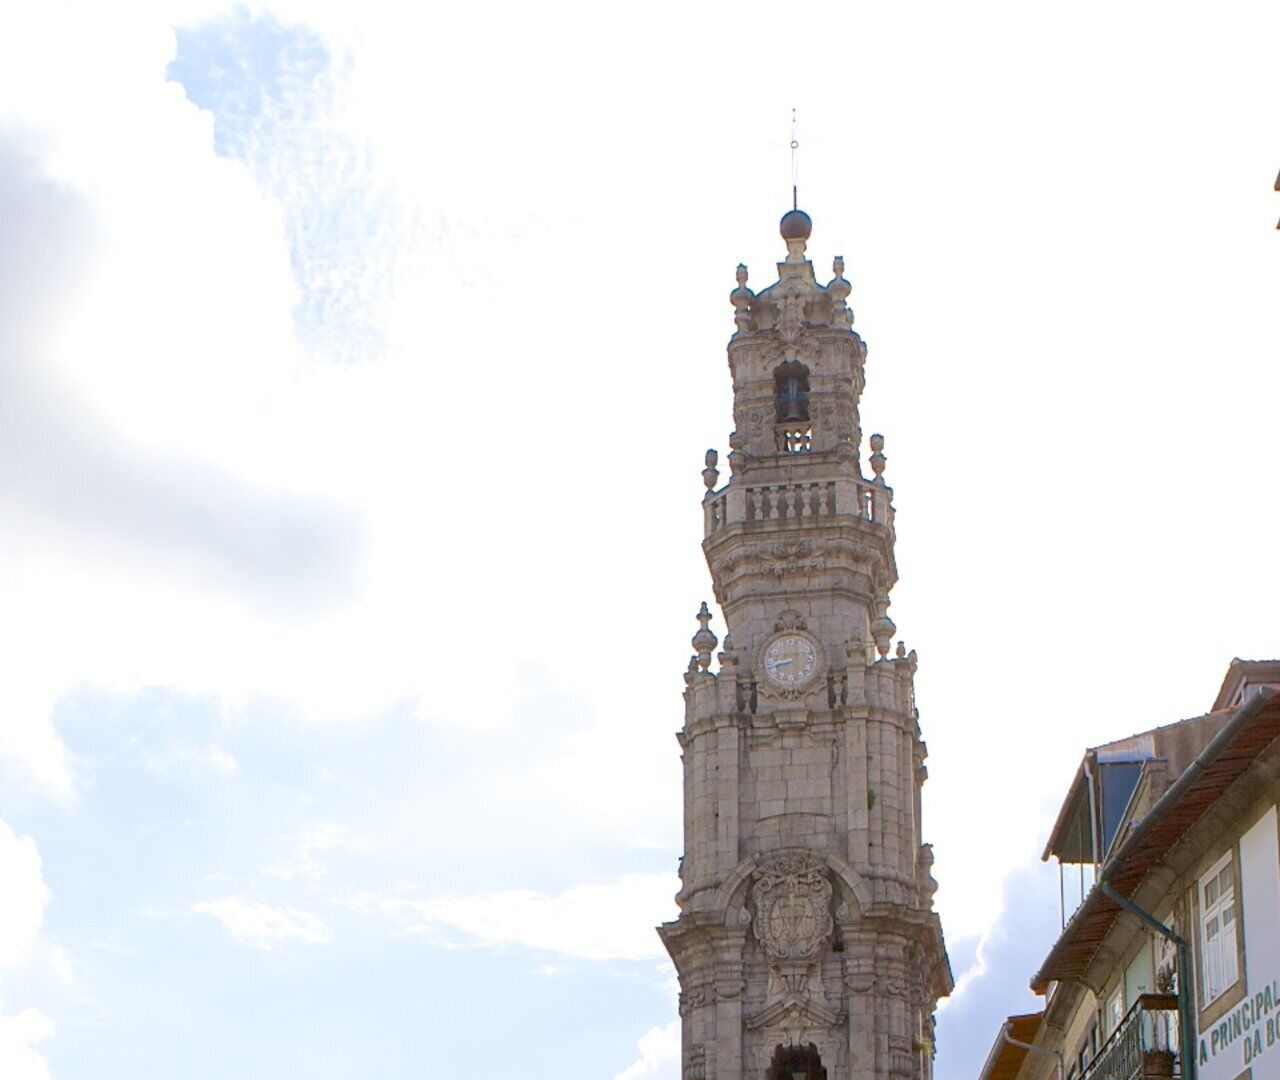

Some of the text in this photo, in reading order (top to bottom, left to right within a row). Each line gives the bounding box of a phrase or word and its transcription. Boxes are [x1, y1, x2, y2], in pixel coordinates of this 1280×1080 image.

[1199, 980, 1280, 1067] A PRINCIPAL
[1243, 1029, 1262, 1066] DA
